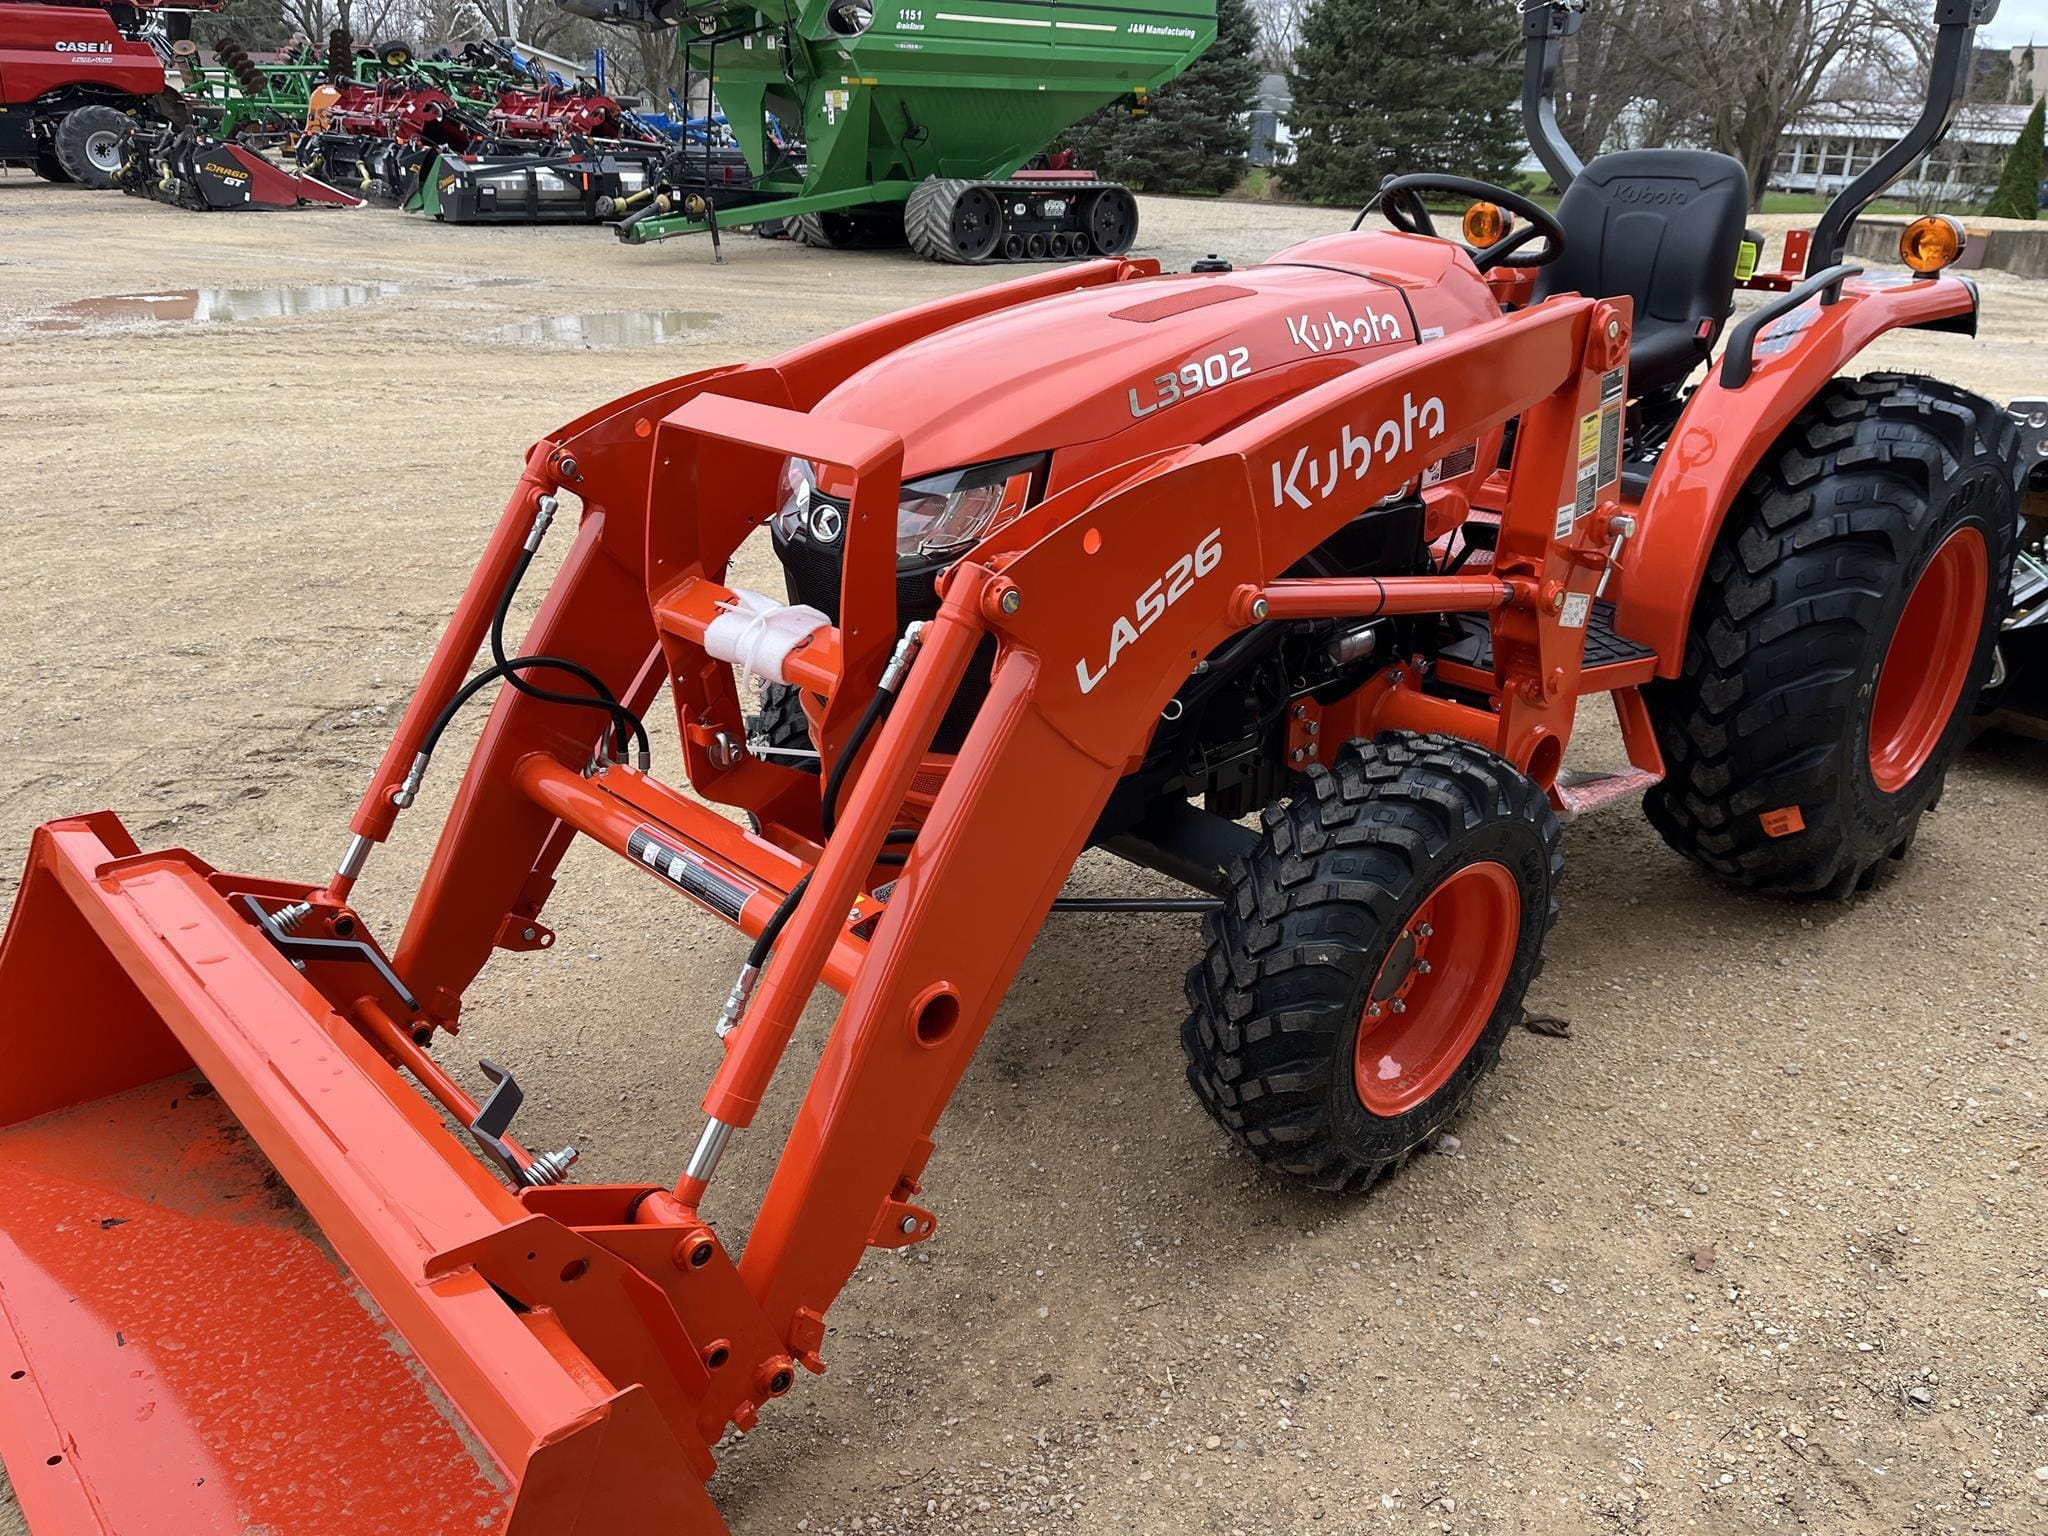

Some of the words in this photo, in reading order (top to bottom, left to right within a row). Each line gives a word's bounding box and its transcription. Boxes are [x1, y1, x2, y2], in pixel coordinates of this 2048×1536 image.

[899, 8, 922, 21] 1151
[1127, 23, 1146, 34] J&M
[1146, 24, 1196, 40] Manufacturing
[55, 41, 98, 53] CASE
[204, 162, 249, 180] DRAGO
[223, 176, 246, 188] GT
[1612, 185, 1689, 205] Kubota
[1285, 306, 1402, 353] Kubota
[1128, 346, 1252, 418] L3902
[1271, 391, 1446, 510] Kubota
[1075, 527, 1223, 695] LA526
